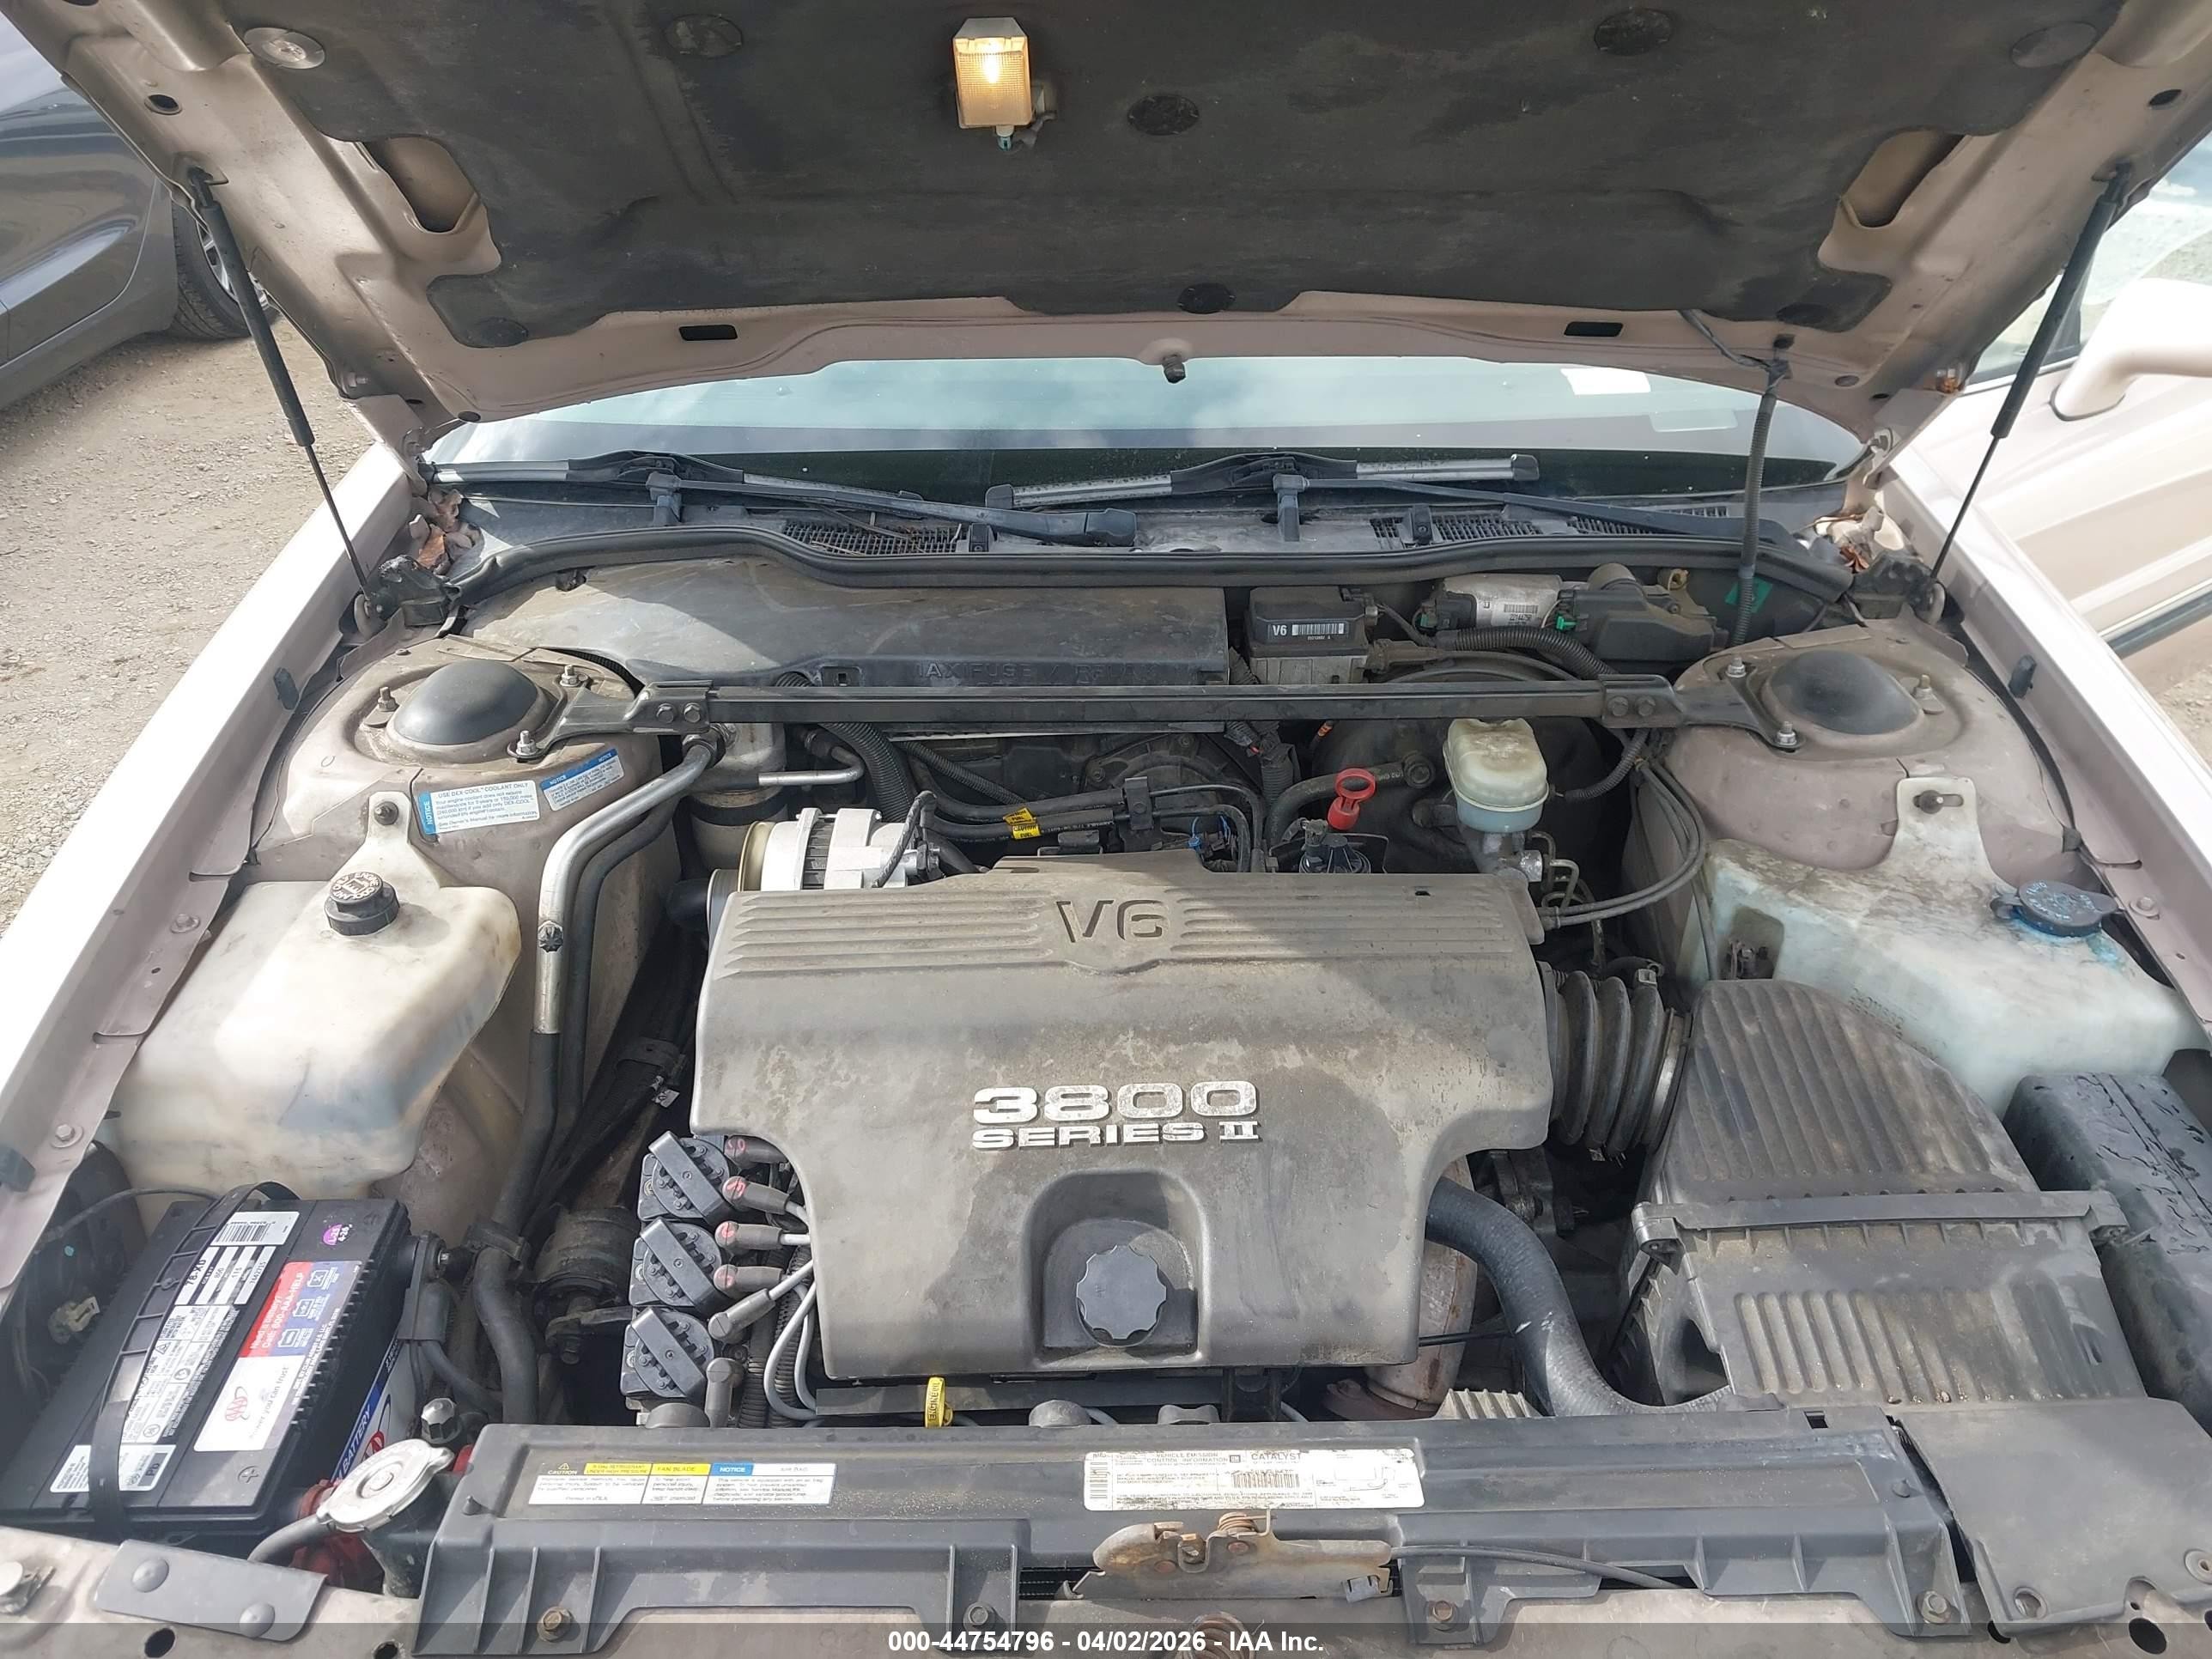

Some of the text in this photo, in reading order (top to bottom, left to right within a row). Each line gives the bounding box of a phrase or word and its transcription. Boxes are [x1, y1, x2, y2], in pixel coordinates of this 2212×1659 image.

[1273, 625, 1287, 635] V6
[484, 784, 513, 793] COOLANT
[550, 775, 566, 785] NOTICE
[424, 801, 433, 825] NOTICE
[1055, 899, 1170, 943] V6
[973, 1080, 1259, 1125] 3800
[972, 1121, 1261, 1150] SERIES II
[275, 1273, 304, 1328] 800-AAA-HELP
[264, 1400, 275, 1413] you
[272, 1386, 282, 1399] can
[277, 1367, 289, 1386] trust
[928, 1392, 939, 1419] ENGINE
[343, 1404, 371, 1472] BATTERY
[1251, 1452, 1302, 1461] CATALYST
